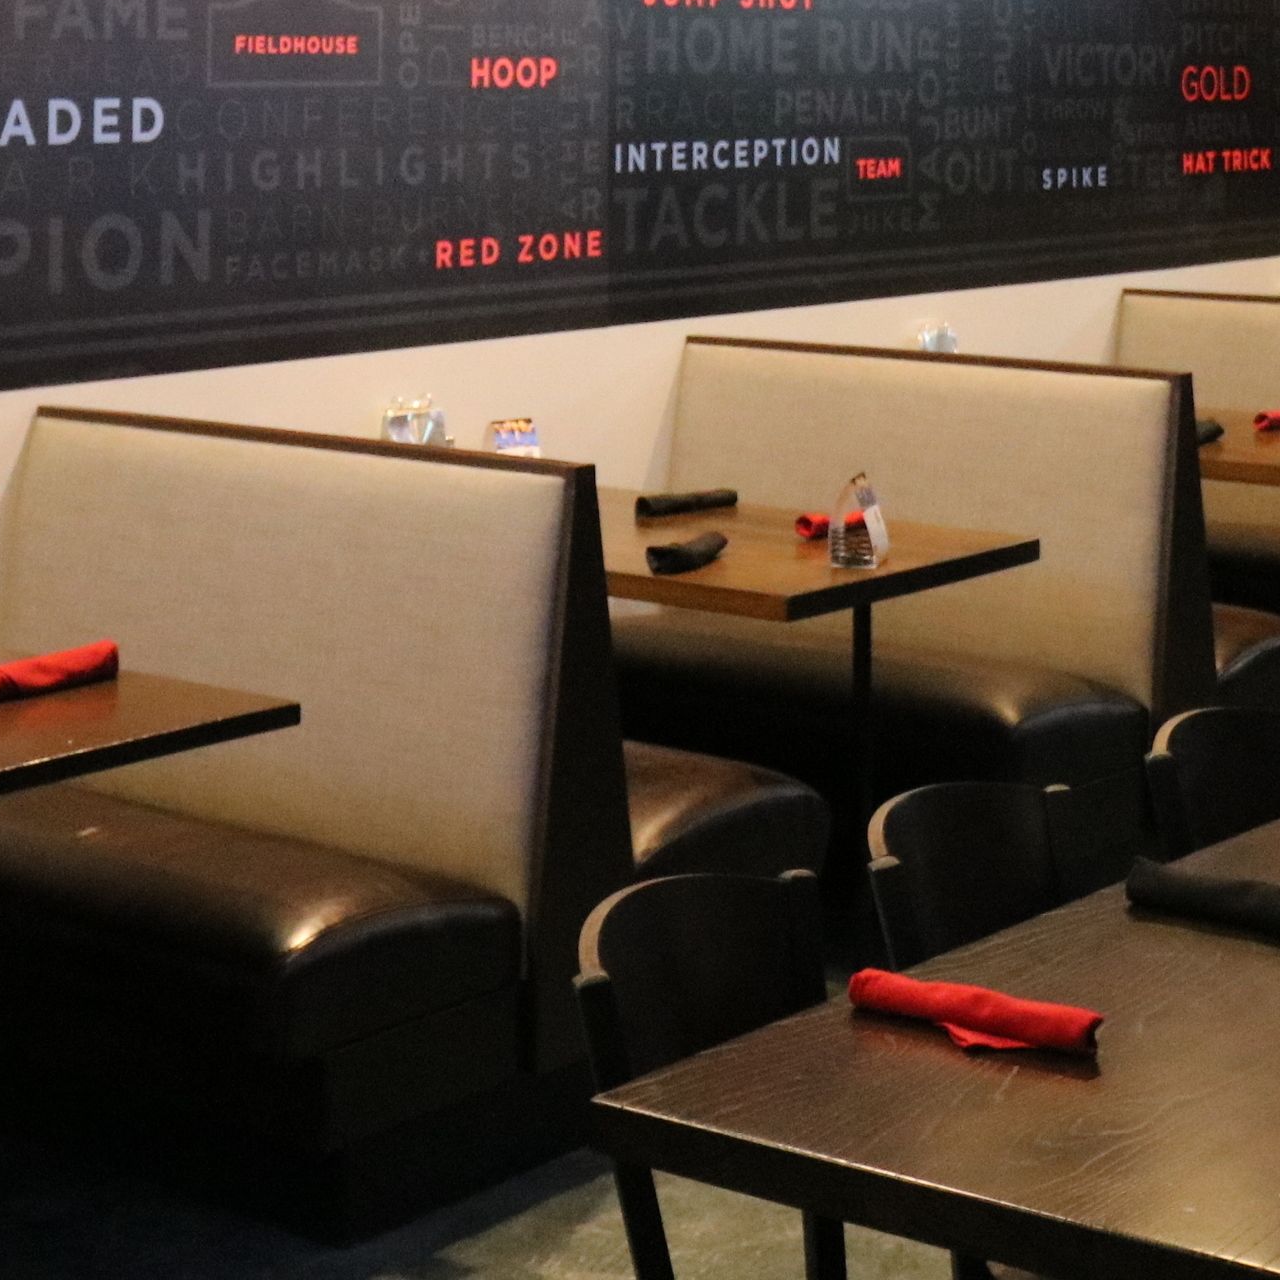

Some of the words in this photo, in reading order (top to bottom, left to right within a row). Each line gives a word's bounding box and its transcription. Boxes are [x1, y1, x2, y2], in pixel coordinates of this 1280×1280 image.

[233, 34, 360, 58] FIELDHOUSE
[470, 56, 559, 89] HOOP
[1179, 63, 1252, 103] GOLD
[613, 134, 842, 174] INTERCEPTION
[1181, 150, 1217, 175] HAT
[1221, 147, 1273, 172] TRICK
[854, 157, 903, 182] TEAM
[1041, 164, 1109, 191] SPIKE
[434, 235, 501, 270] RED
[516, 229, 604, 264] ZONE
